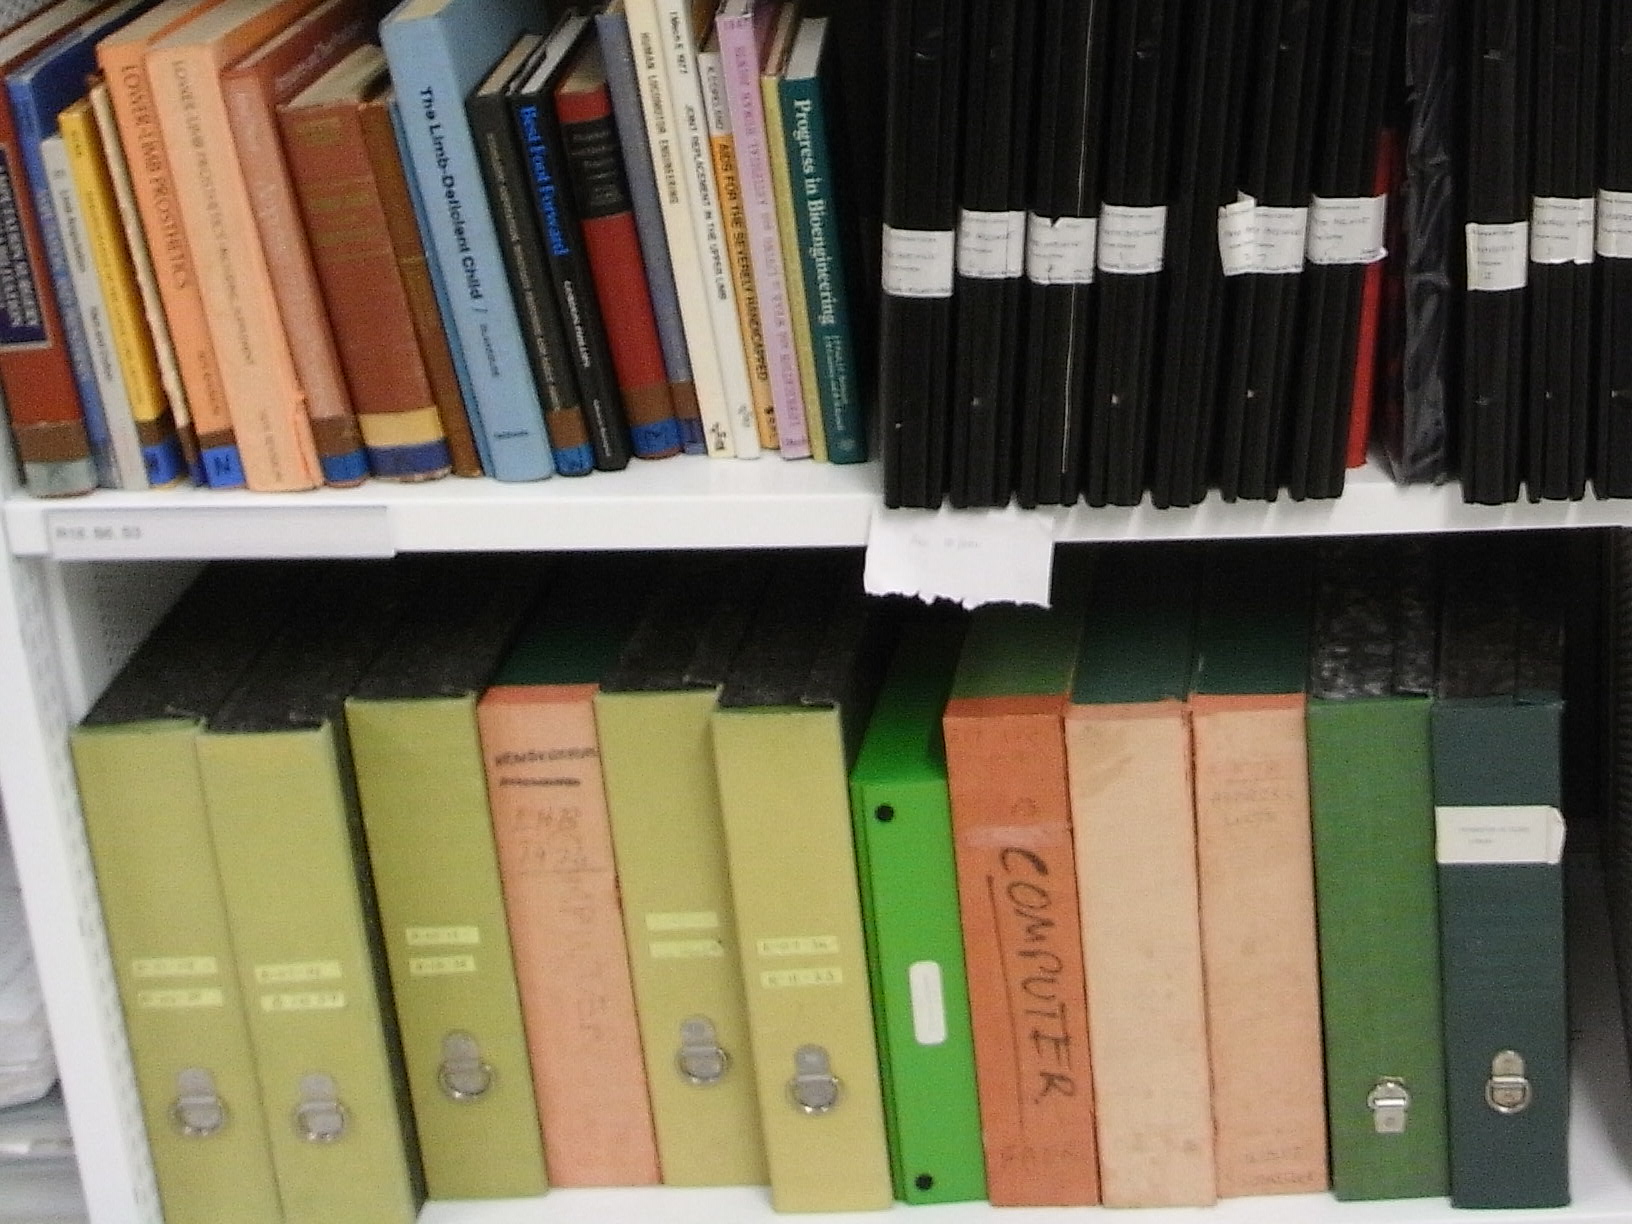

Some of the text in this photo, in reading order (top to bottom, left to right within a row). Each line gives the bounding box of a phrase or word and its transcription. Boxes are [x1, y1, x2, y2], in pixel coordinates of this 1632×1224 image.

[716, 142, 734, 173] AIDS
[792, 97, 821, 174] Progress
[418, 86, 484, 300] The Limb-Deficient Child
[519, 105, 572, 257] Best Foot Forward
[722, 175, 739, 202] FOR
[727, 204, 744, 230] THE
[807, 175, 825, 195] in
[806, 197, 844, 327] Bioengineering
[1000, 846, 1077, 1105] COMPUTER
